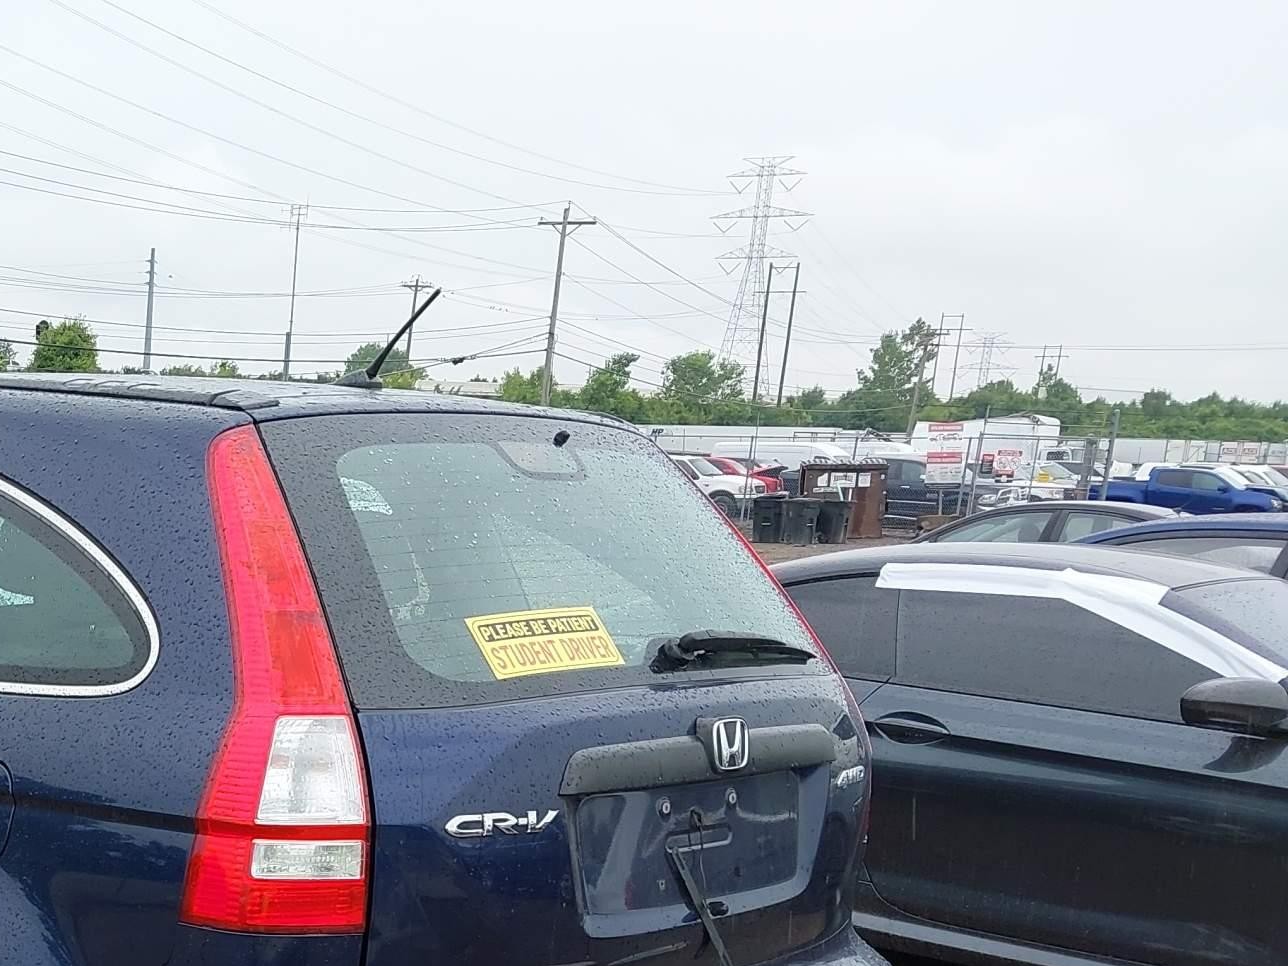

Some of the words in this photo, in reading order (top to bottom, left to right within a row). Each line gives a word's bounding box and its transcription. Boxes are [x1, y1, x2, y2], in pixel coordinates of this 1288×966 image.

[479, 622, 533, 641] PLEASE
[529, 620, 550, 635] BE
[547, 615, 598, 634] PATIENT
[491, 639, 562, 671] STUDENT
[559, 635, 616, 663] DRIVER
[444, 809, 560, 838] CR-V
